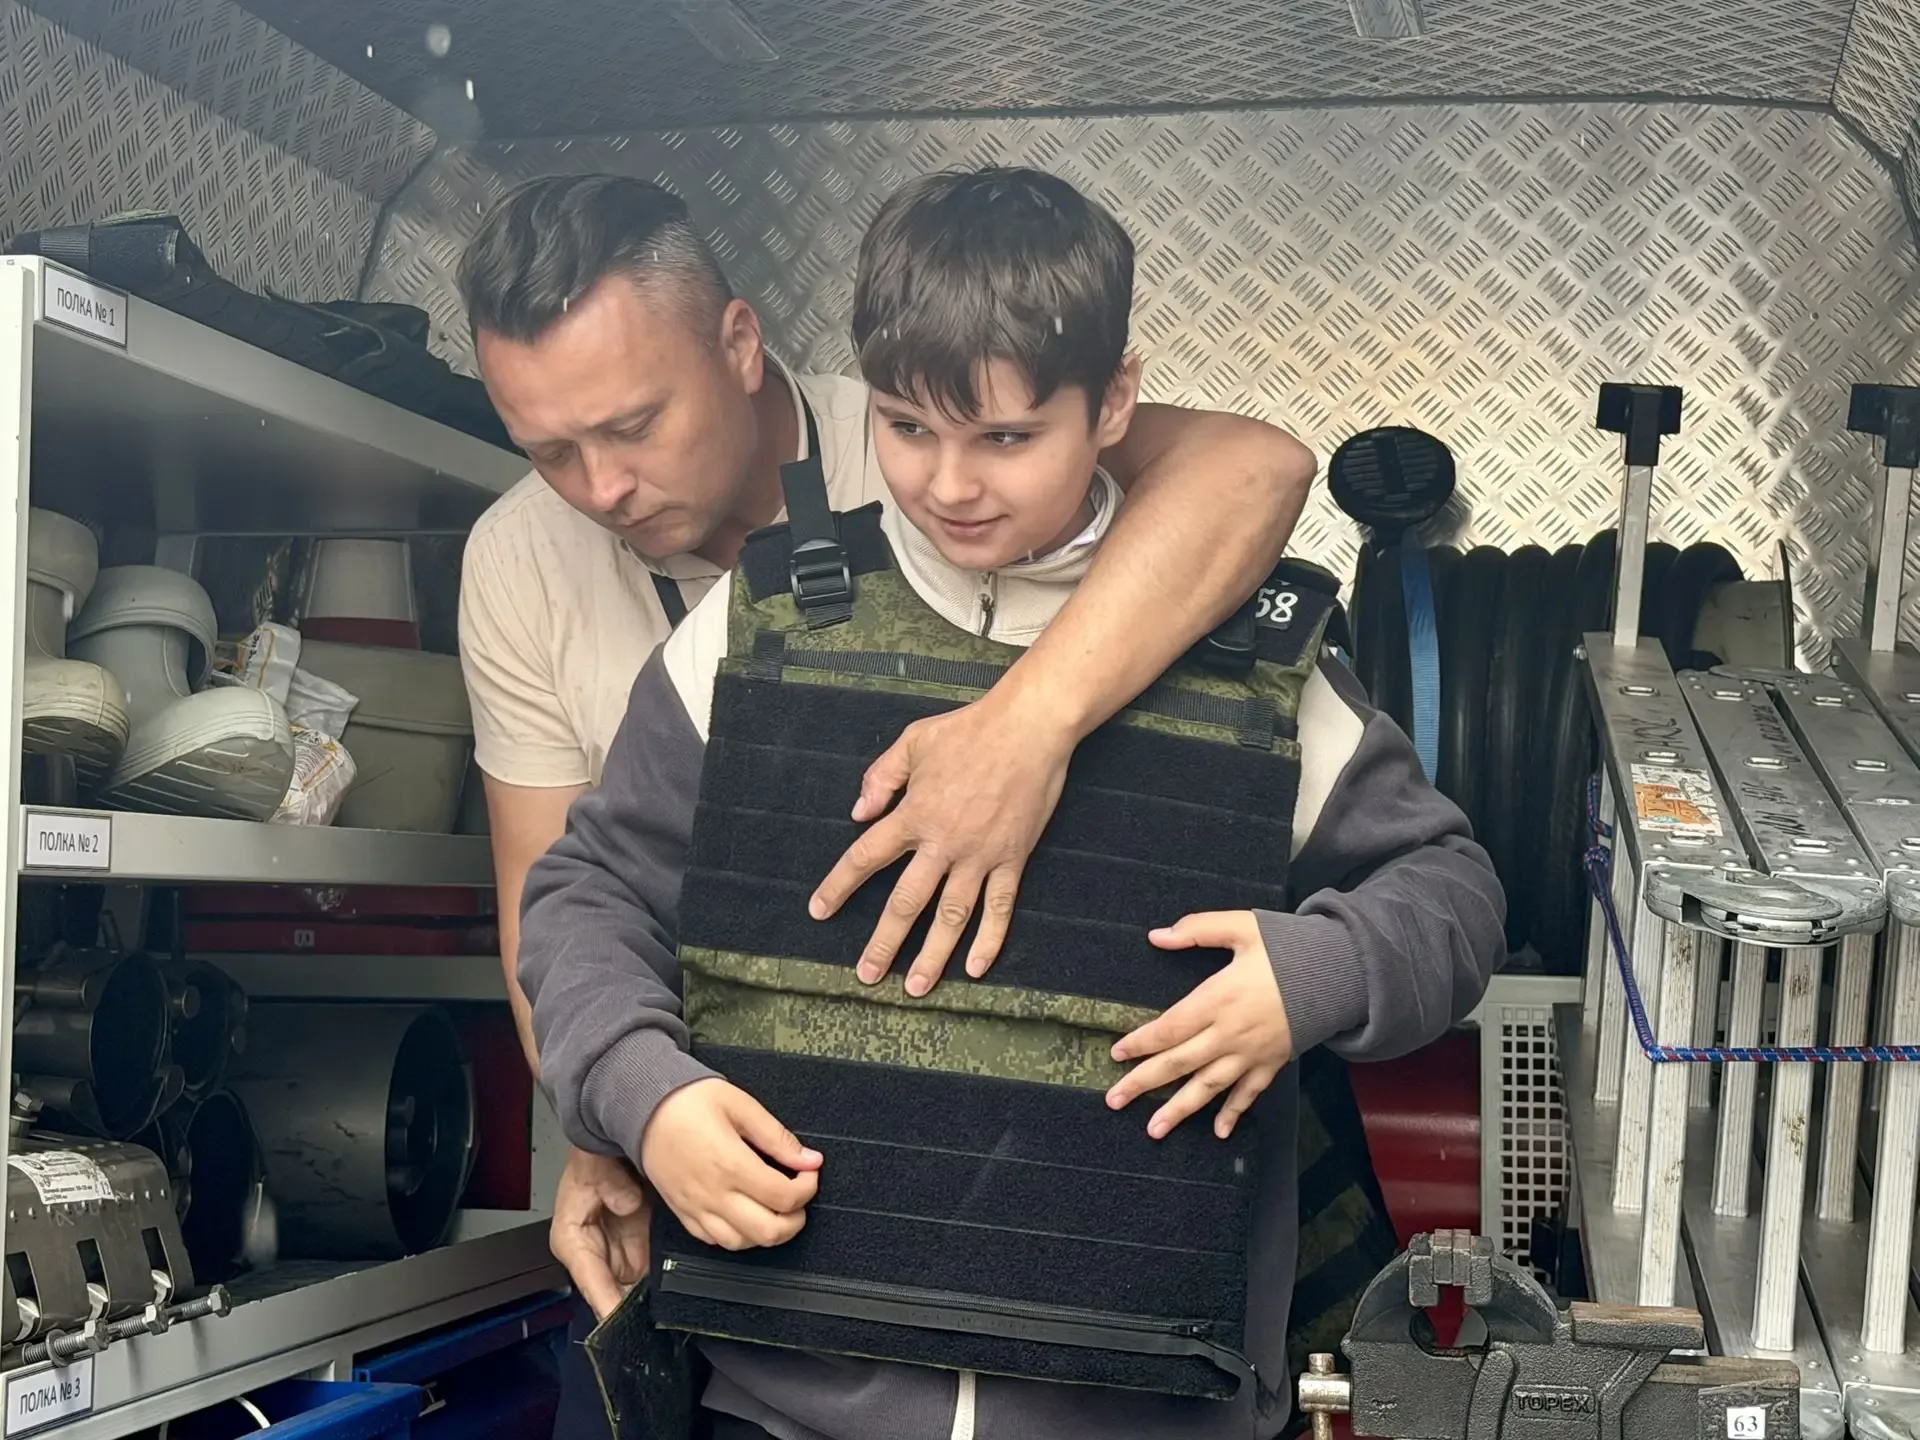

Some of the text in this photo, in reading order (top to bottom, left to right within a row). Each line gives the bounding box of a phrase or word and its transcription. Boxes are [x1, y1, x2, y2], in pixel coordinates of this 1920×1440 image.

[57, 287, 115, 326] ПОЛКА № 1
[40, 831, 99, 853] ПОЛКА № 2
[20, 1377, 81, 1415] ПОЛКА № 3
[1515, 1391, 1591, 1413] TOPEX
[1734, 1415, 1758, 1432] 63
